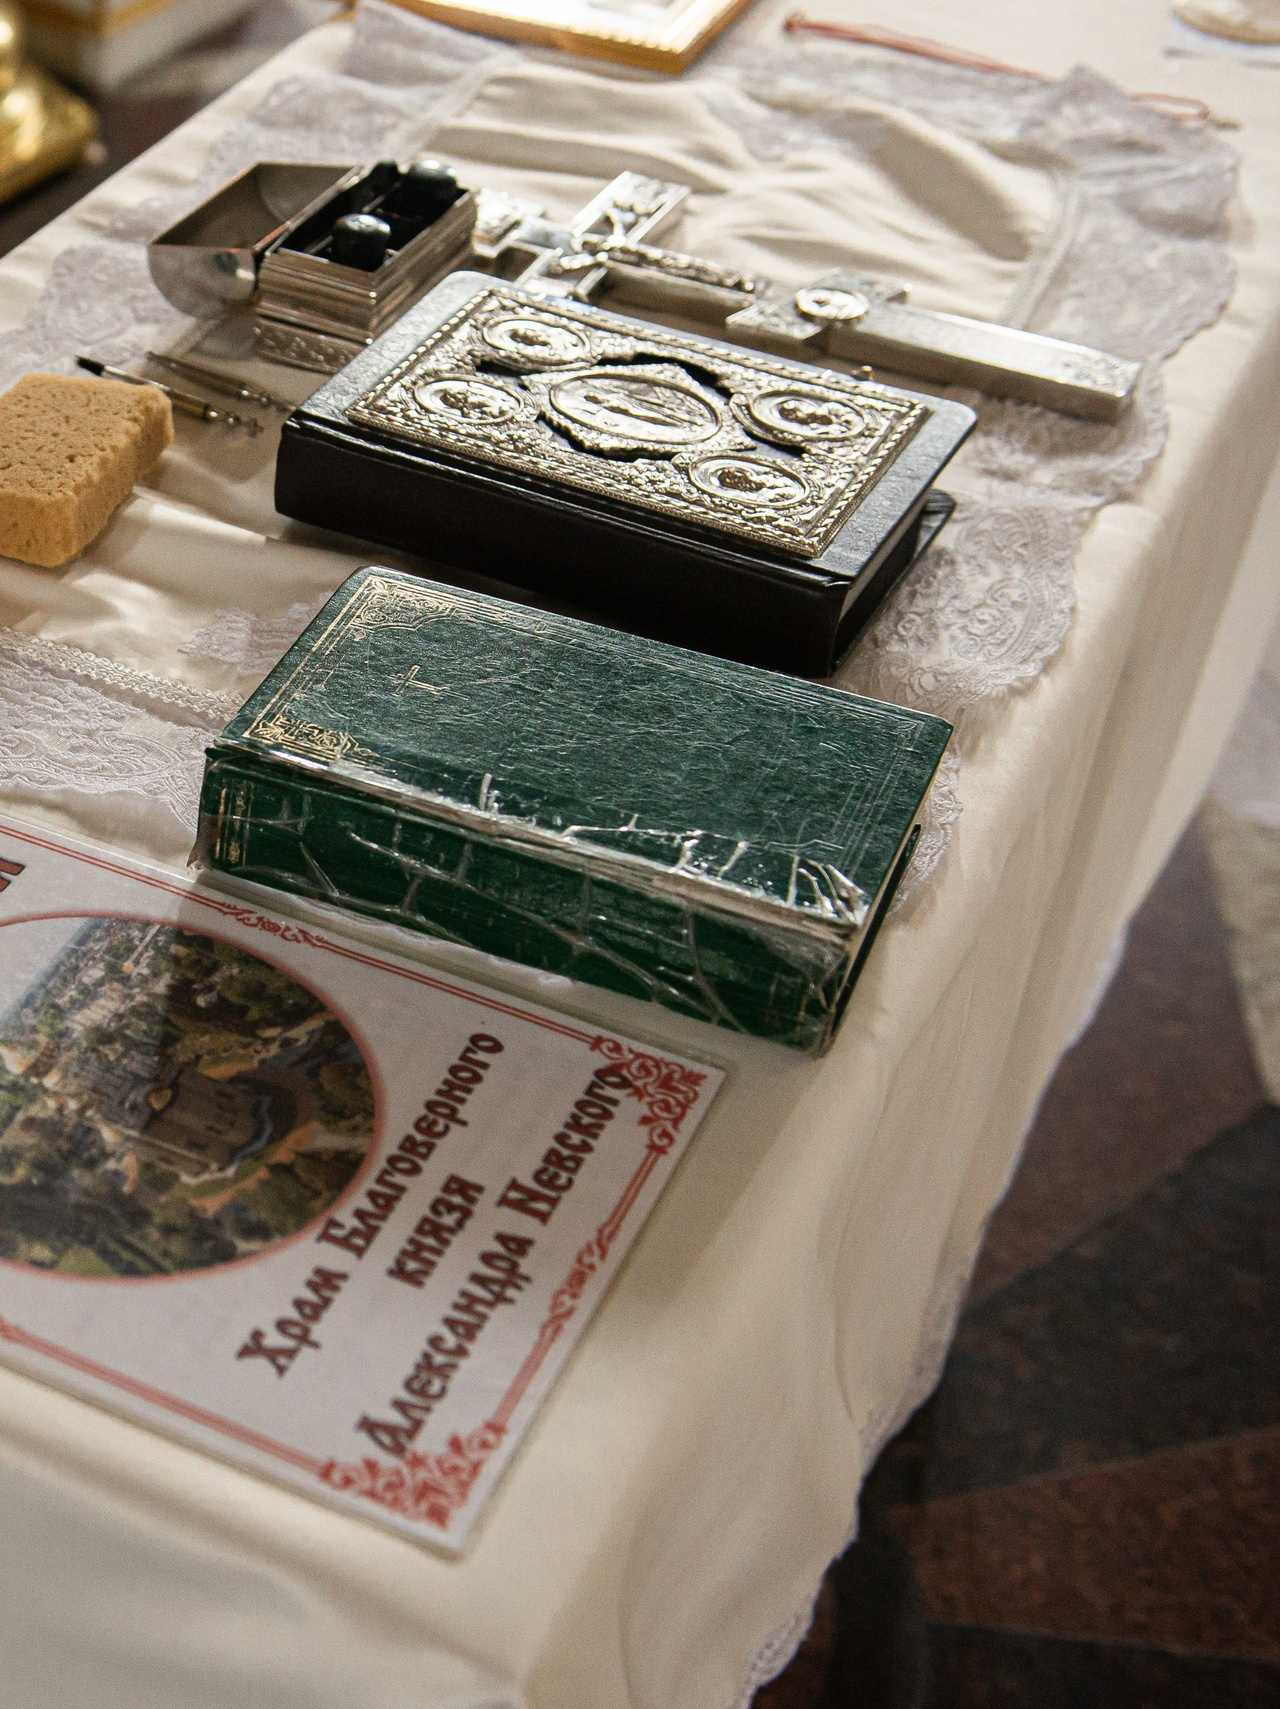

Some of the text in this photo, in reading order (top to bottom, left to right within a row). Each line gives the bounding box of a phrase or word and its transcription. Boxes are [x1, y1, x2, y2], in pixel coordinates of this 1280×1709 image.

[237, 1032, 505, 1377] Храм Благоверного
[356, 1067, 634, 1458] Александра Невского
